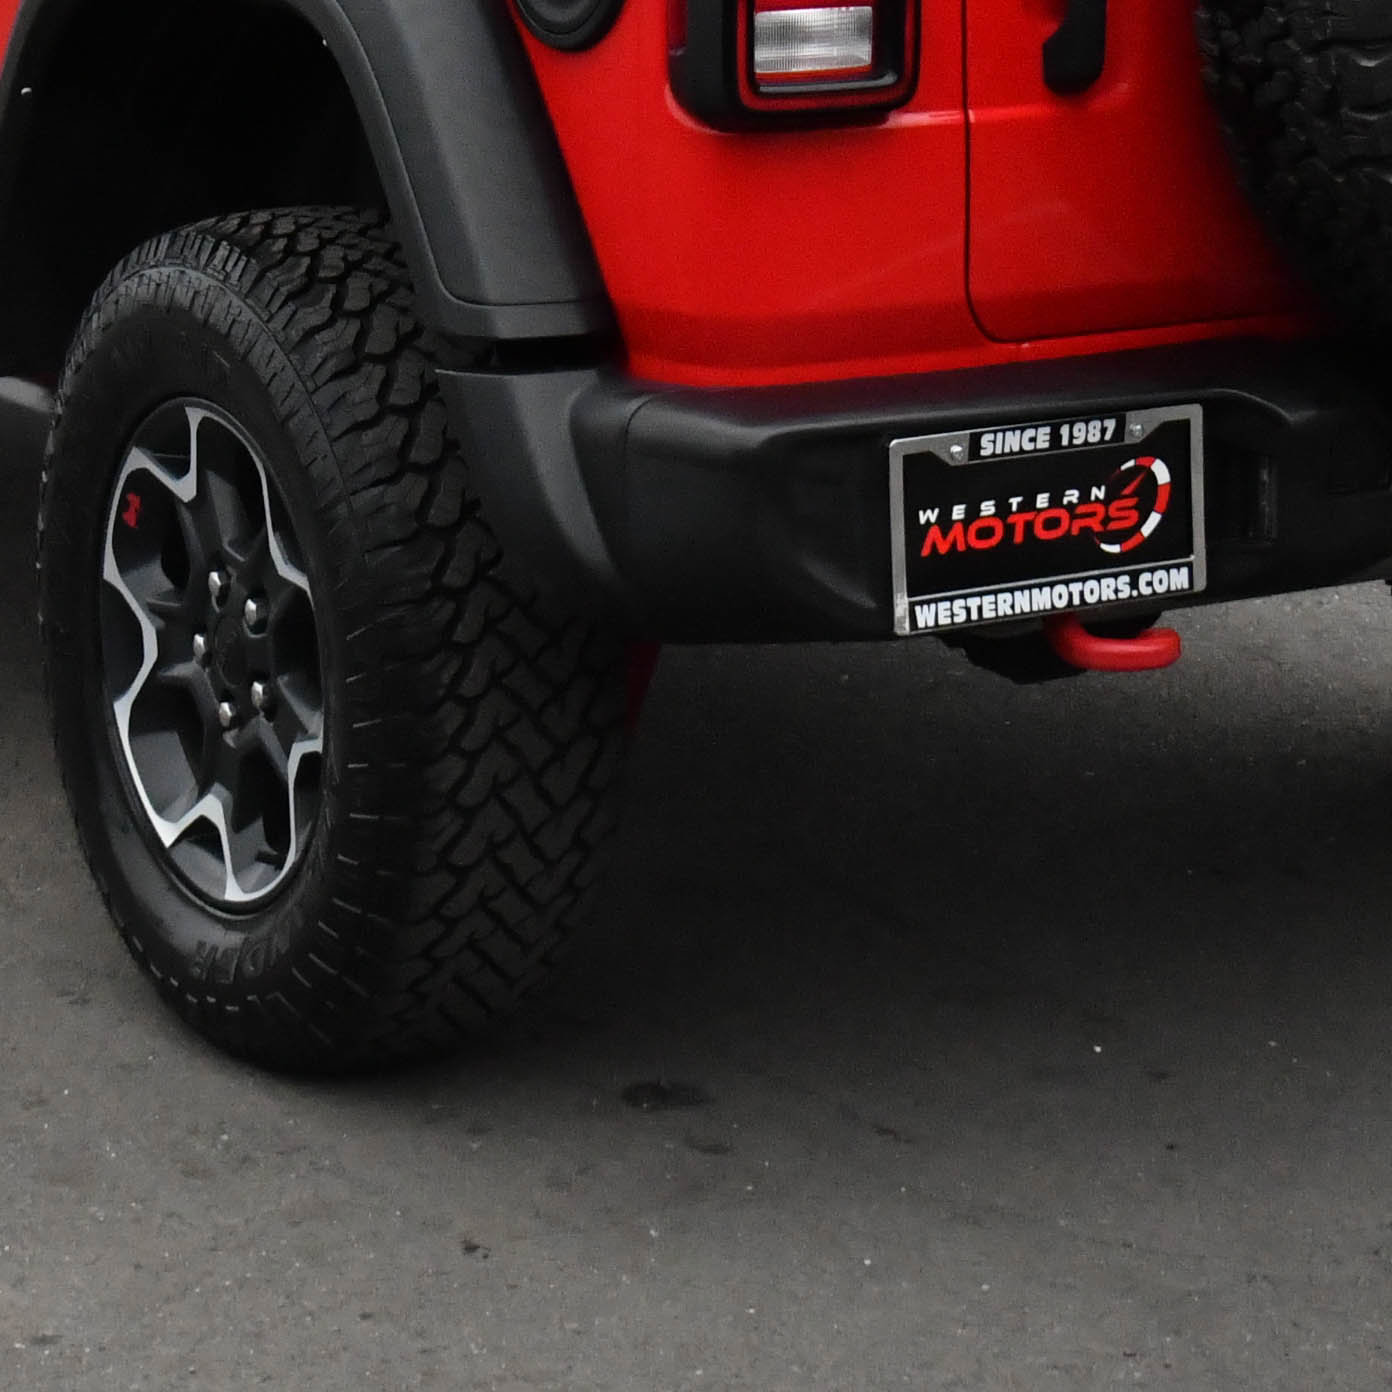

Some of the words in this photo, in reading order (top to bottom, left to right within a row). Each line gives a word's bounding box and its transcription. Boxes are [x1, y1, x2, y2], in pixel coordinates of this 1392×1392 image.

[979, 426, 1051, 457] SINCE
[1059, 418, 1116, 447] 1987
[918, 484, 1107, 525] WESTERN
[920, 497, 1139, 557] MOTORS
[914, 566, 1190, 629] WESTERNMOTORS.COM
